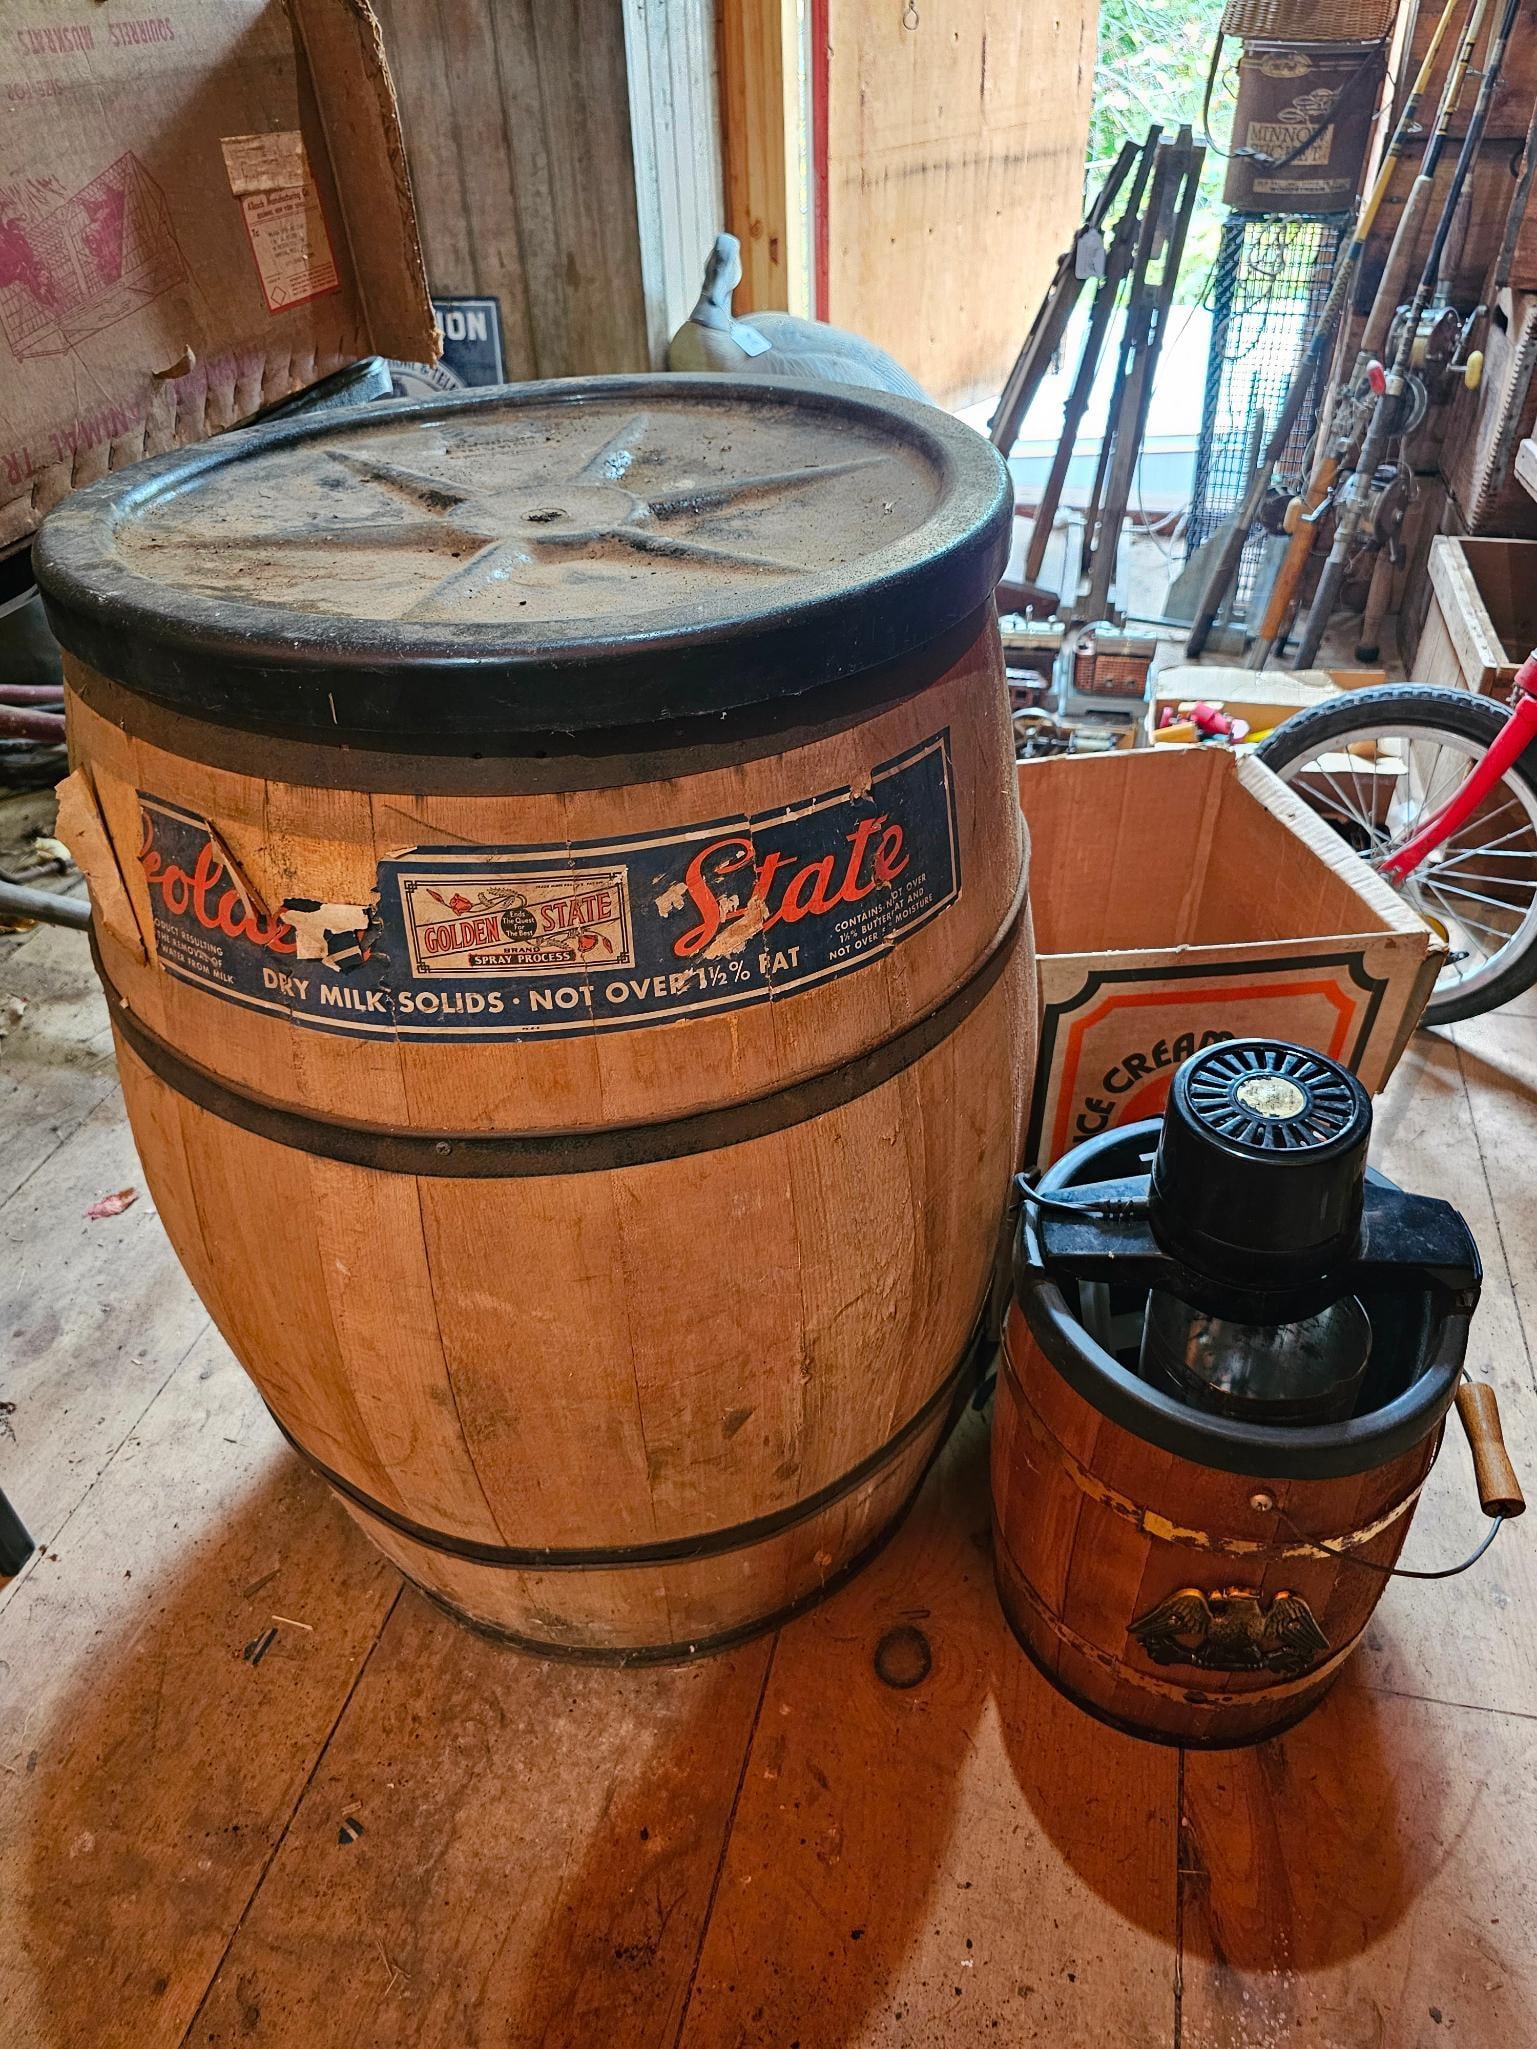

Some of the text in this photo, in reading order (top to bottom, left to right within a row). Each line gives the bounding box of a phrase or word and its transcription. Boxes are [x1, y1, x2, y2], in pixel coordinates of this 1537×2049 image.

[17, 17, 174, 56] SQUIRRELS MUSKRATS
[1251, 125, 1328, 144] MINNO
[673, 815, 910, 957] State
[835, 904, 883, 932] CONTAINS
[906, 873, 926, 891] OVER
[907, 888, 924, 904] AND
[154, 918, 224, 956] ODUCT RESULTING
[424, 892, 612, 953] GOLDEN STATE
[829, 893, 933, 961] NOT OVER MOISTURE
[188, 957, 211, 974] FROM
[213, 969, 234, 984] MILK
[262, 967, 309, 1000] DRY
[320, 984, 387, 1013] MILK
[399, 991, 504, 1014] SOLIDS
[529, 985, 594, 1012] NOT
[605, 968, 691, 1004] OVER
[758, 946, 800, 975] FAT
[474, 952, 571, 964] SPRAY PROCESS
[1103, 1030, 1236, 1094] CREAM
